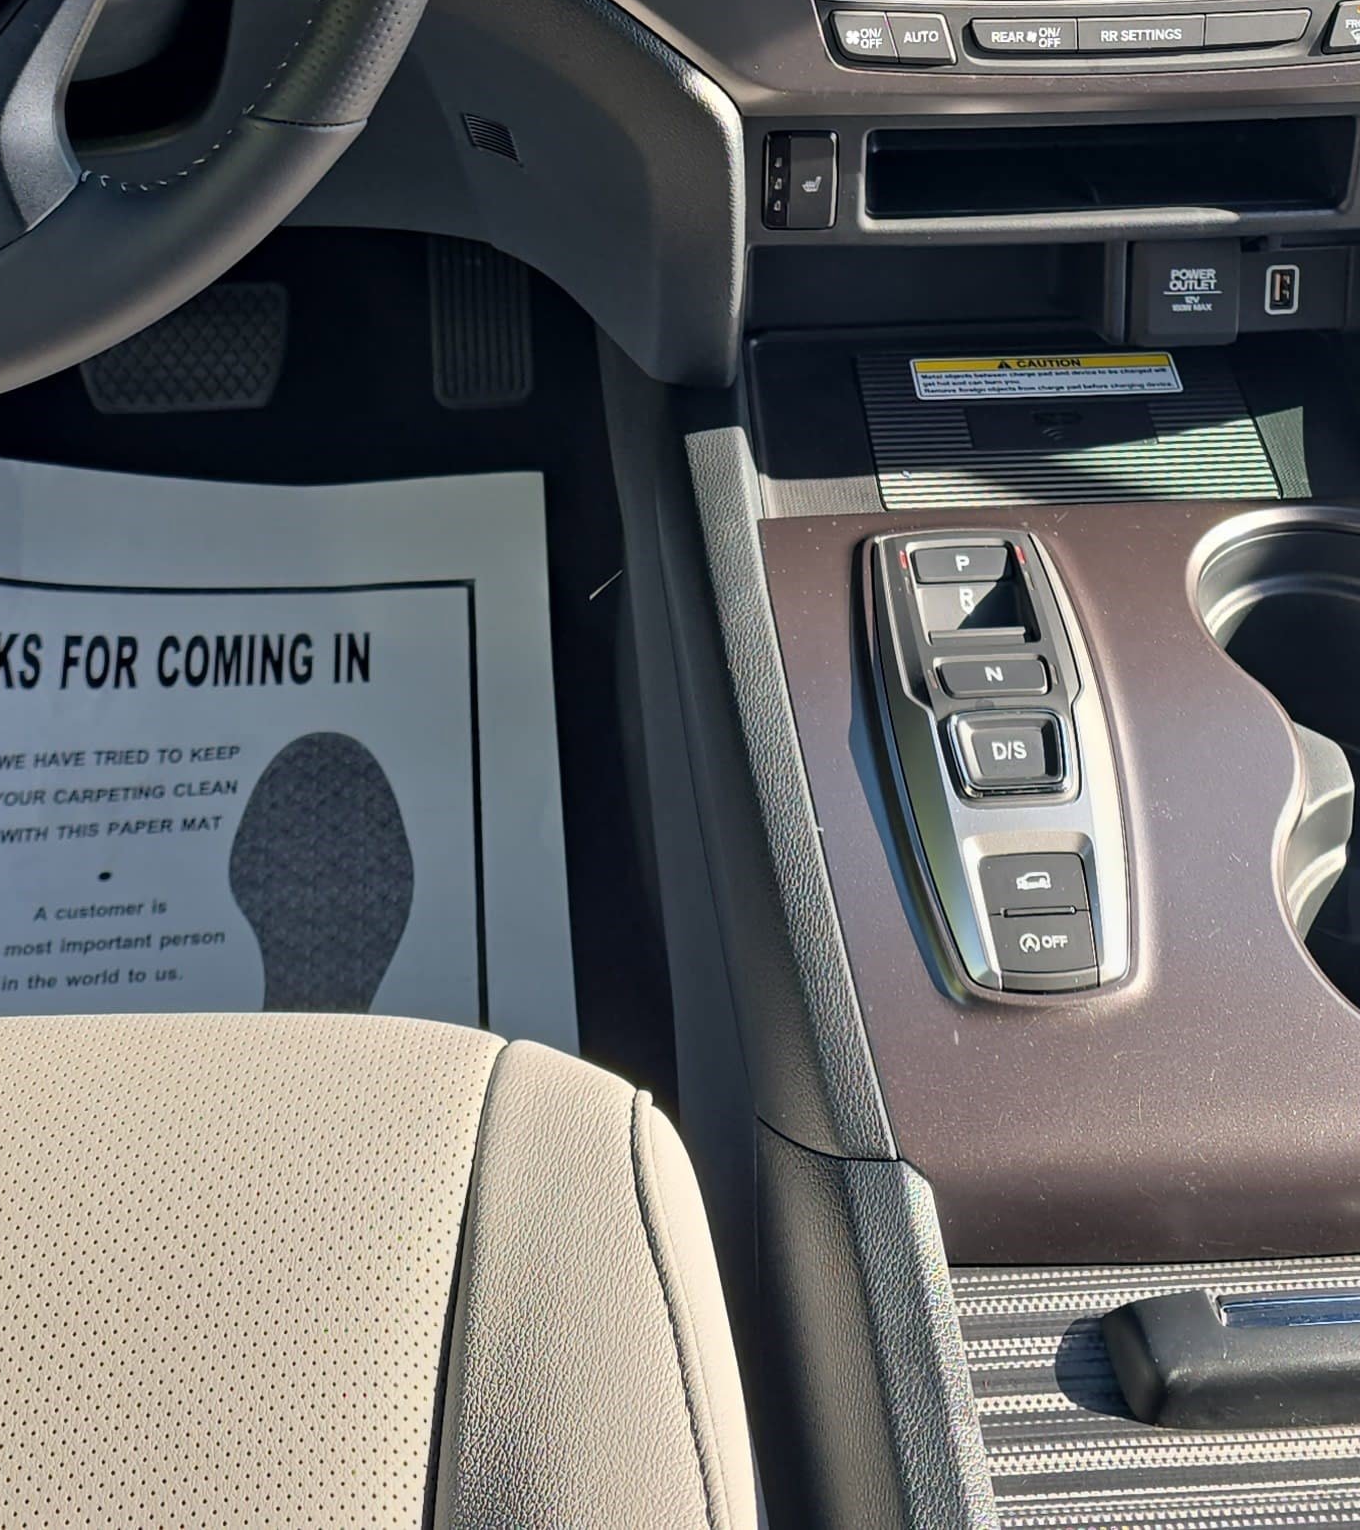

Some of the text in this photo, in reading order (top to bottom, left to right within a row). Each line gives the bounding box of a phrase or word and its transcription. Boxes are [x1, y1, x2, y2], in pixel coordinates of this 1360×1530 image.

[860, 28, 883, 38] ON/
[903, 31, 940, 44] AUTO
[991, 27, 1061, 44] REAR ON/
[1100, 28, 1183, 42] RR SETTINGS
[860, 38, 883, 50] OFF
[1039, 37, 1061, 49] OFF
[1170, 268, 1217, 280] POWER
[1169, 279, 1218, 291] OUTLET
[1016, 357, 1081, 368] CAUTION
[955, 555, 970, 571] P
[59, 634, 138, 690] FOR
[157, 631, 314, 688] COMING
[333, 631, 372, 683] IN
[984, 666, 1004, 682] N
[33, 750, 86, 769] HAVE
[93, 749, 150, 767] TRIED
[156, 748, 183, 765] TO
[189, 745, 241, 763] KEEP
[991, 741, 1027, 760] D/S
[53, 784, 167, 805] CARPETING
[173, 779, 239, 798] CLEAN
[0, 815, 224, 845] WITH THIS PAPER MAT
[33, 898, 168, 921] A customer is
[4, 939, 53, 957] most
[60, 933, 153, 956] important
[158, 930, 226, 951] person
[1041, 935, 1068, 948] OFF
[1, 966, 183, 993] in the world to us.
